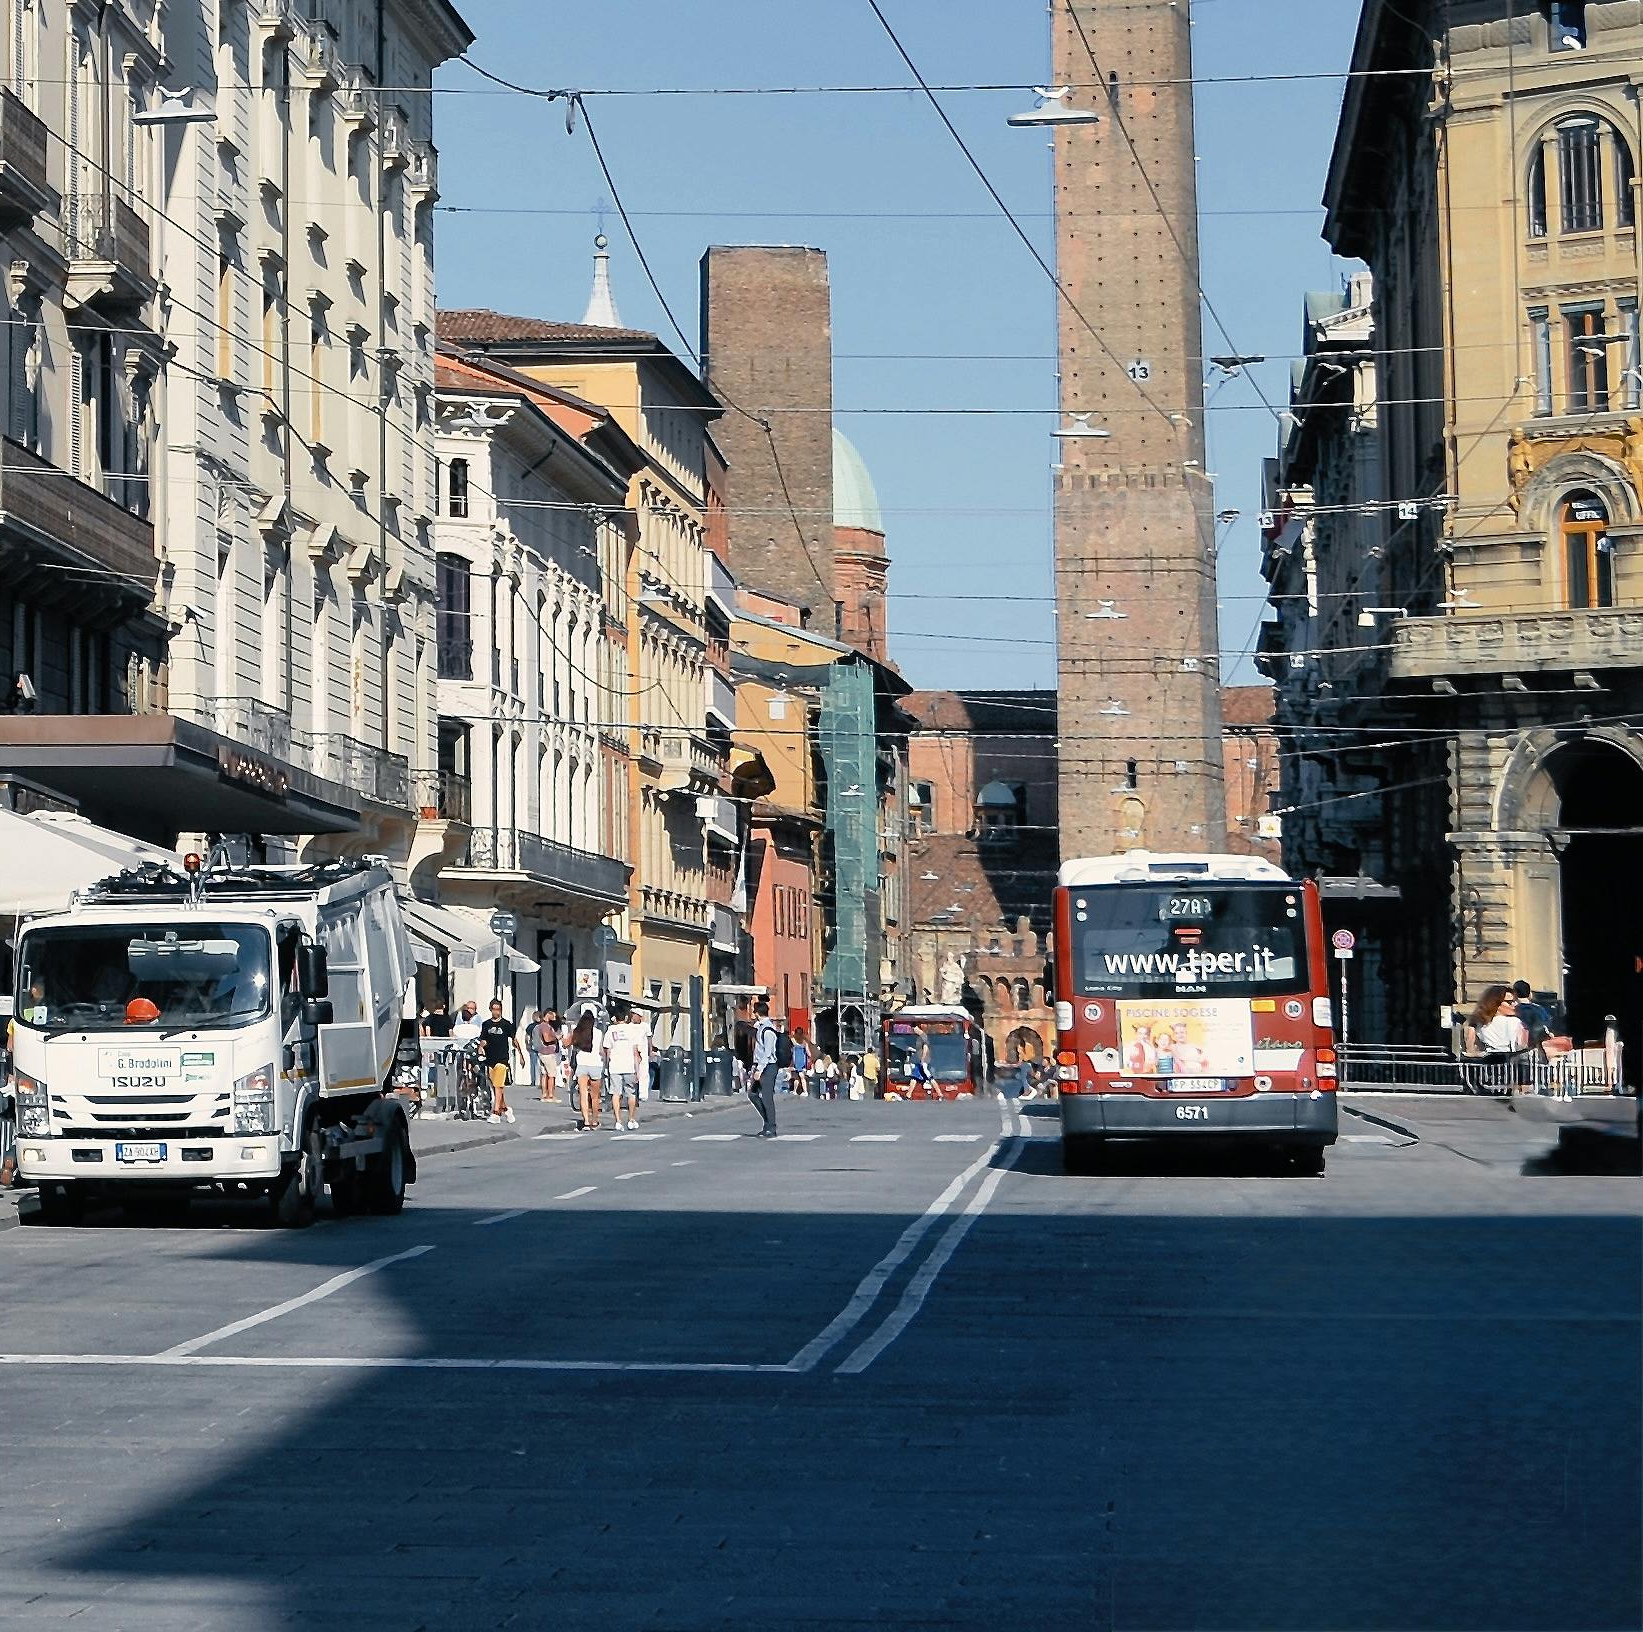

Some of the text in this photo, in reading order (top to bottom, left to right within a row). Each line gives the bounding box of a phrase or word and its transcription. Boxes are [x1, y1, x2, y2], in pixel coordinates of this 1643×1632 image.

[1104, 944, 1275, 981] www.tper.it
[1125, 1007, 1218, 1018] PISCINE SOGESE
[112, 1076, 166, 1088] ISUZU
[1176, 1106, 1209, 1120] 6571
